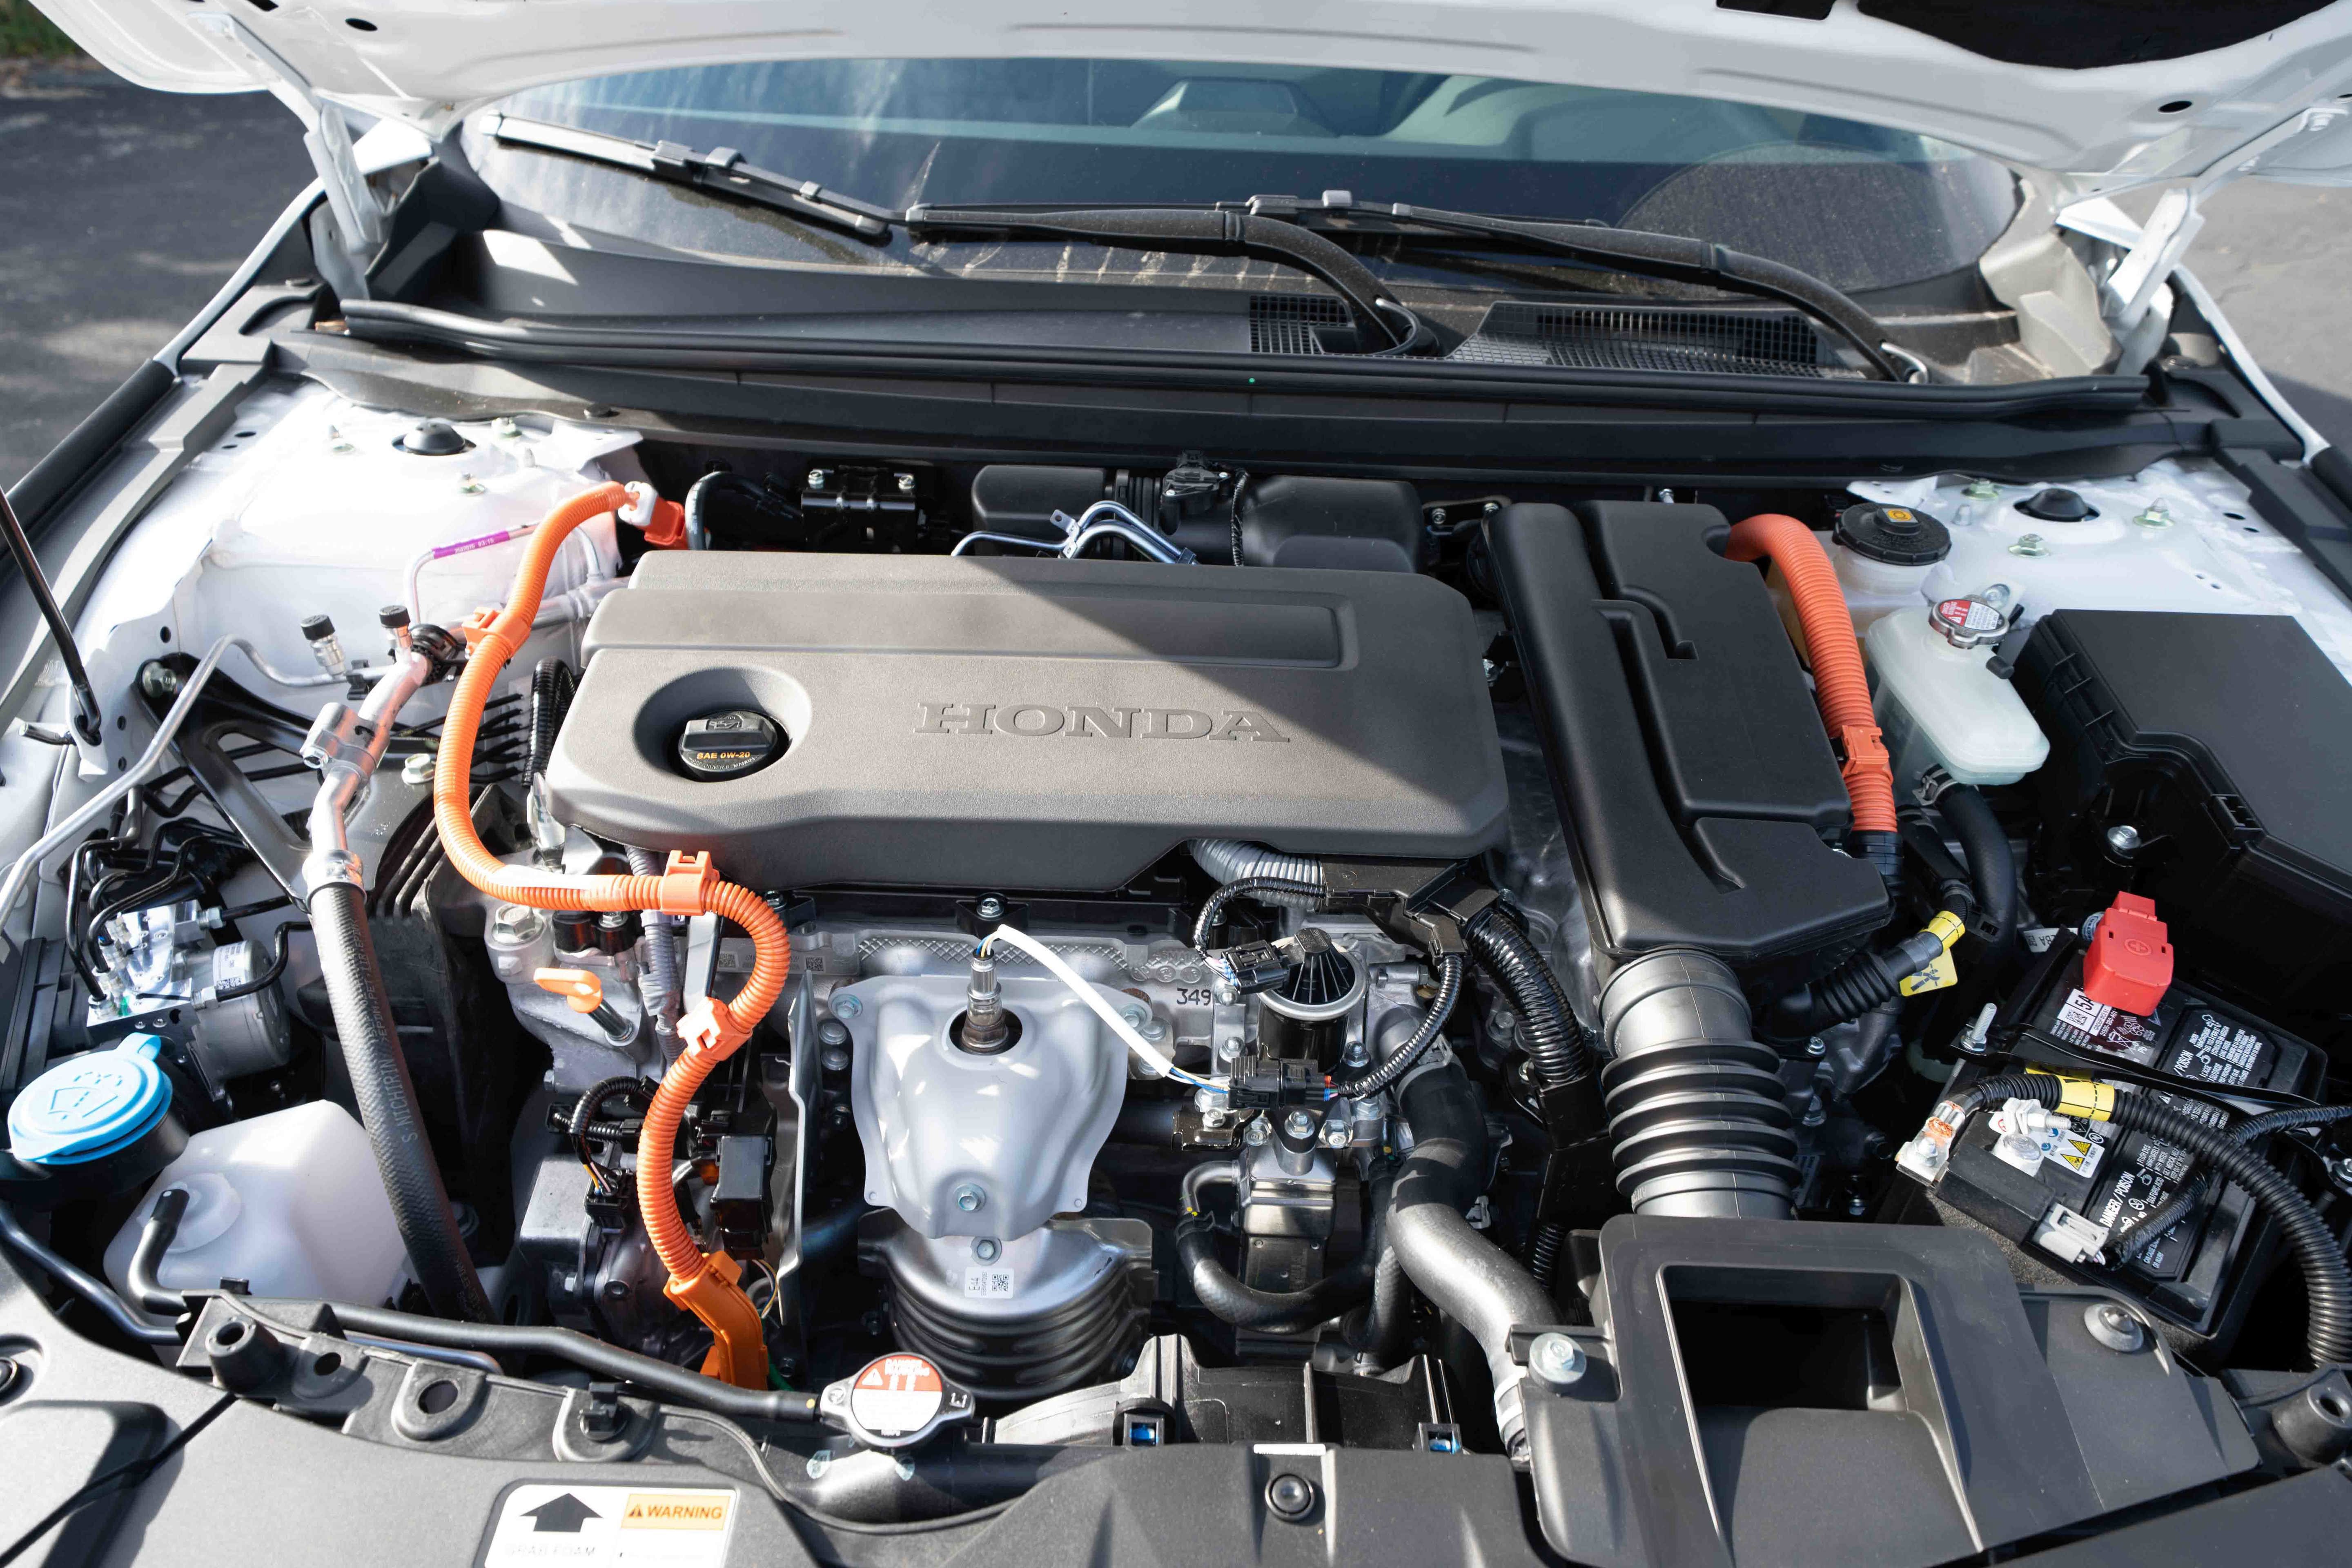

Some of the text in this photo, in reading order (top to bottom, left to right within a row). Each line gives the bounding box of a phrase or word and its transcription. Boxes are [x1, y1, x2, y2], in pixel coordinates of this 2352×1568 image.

[914, 702, 1290, 742] HONDA
[1176, 988, 1211, 1006] 349
[2094, 1018, 2103, 1030] GROUP
[2100, 1011, 2117, 1036] 31500-3B0-A01
[2175, 1050, 2194, 1071] POISON
[2137, 1144, 2151, 1163] FLUSH EYES
[2146, 1146, 2160, 1167] IMMEDIATELY
[2154, 1162, 2163, 1172] WITH
[2162, 1167, 2170, 1176] GET
[2100, 1199, 2121, 1227] DANGER
[2114, 1172, 2134, 1197] POISON
[2146, 1177, 2164, 1204] SULFURIC ACID
[969, 1278, 980, 1290] E44
[647, 1505, 722, 1520] WARNING
